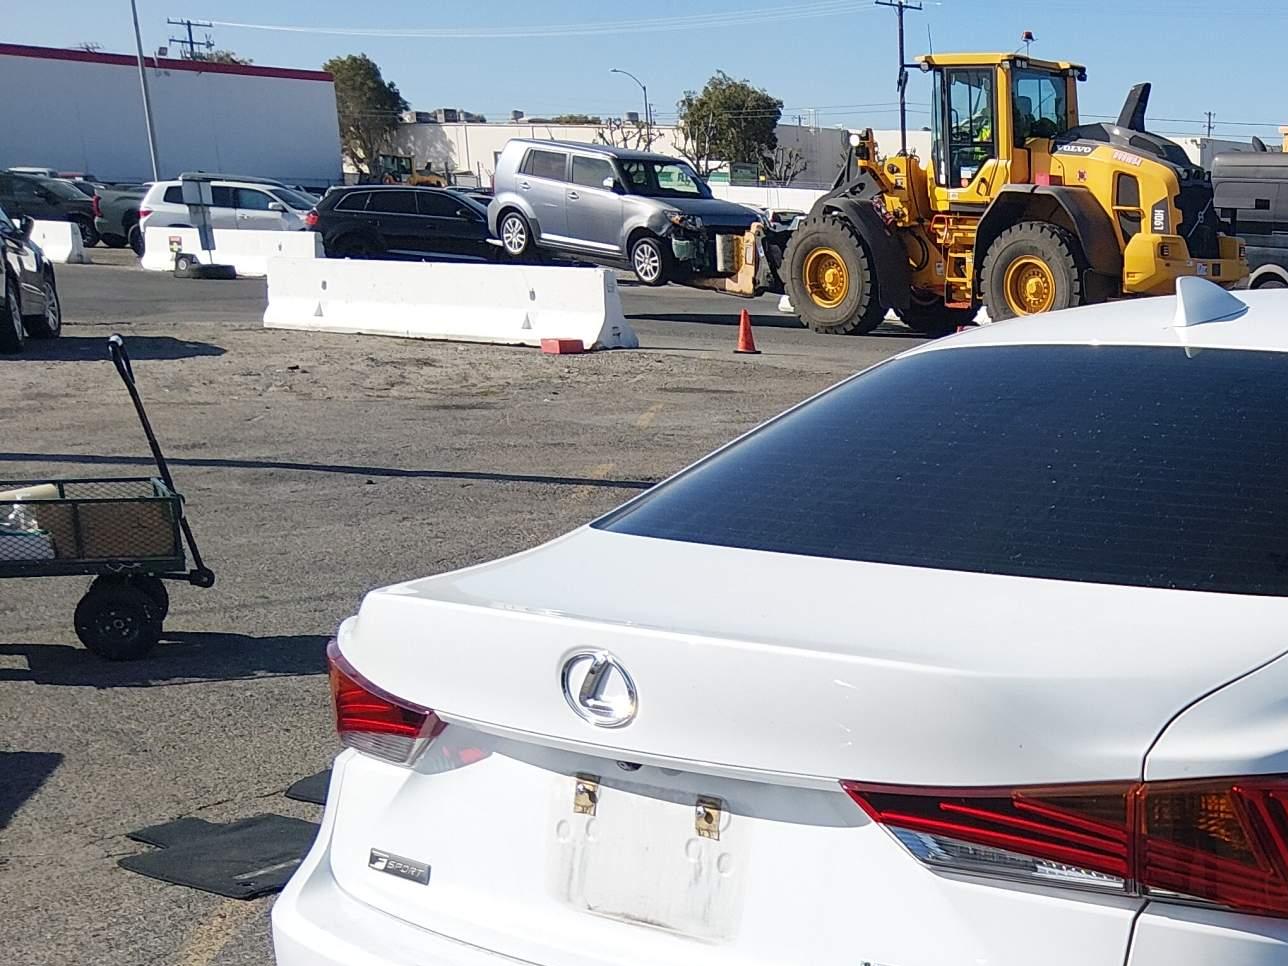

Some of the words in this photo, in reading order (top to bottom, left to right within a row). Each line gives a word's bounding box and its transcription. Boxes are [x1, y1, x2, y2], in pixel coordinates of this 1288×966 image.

[1056, 144, 1092, 153] VOLVO
[1153, 209, 1165, 231] L90H
[386, 860, 425, 878] SPORT
